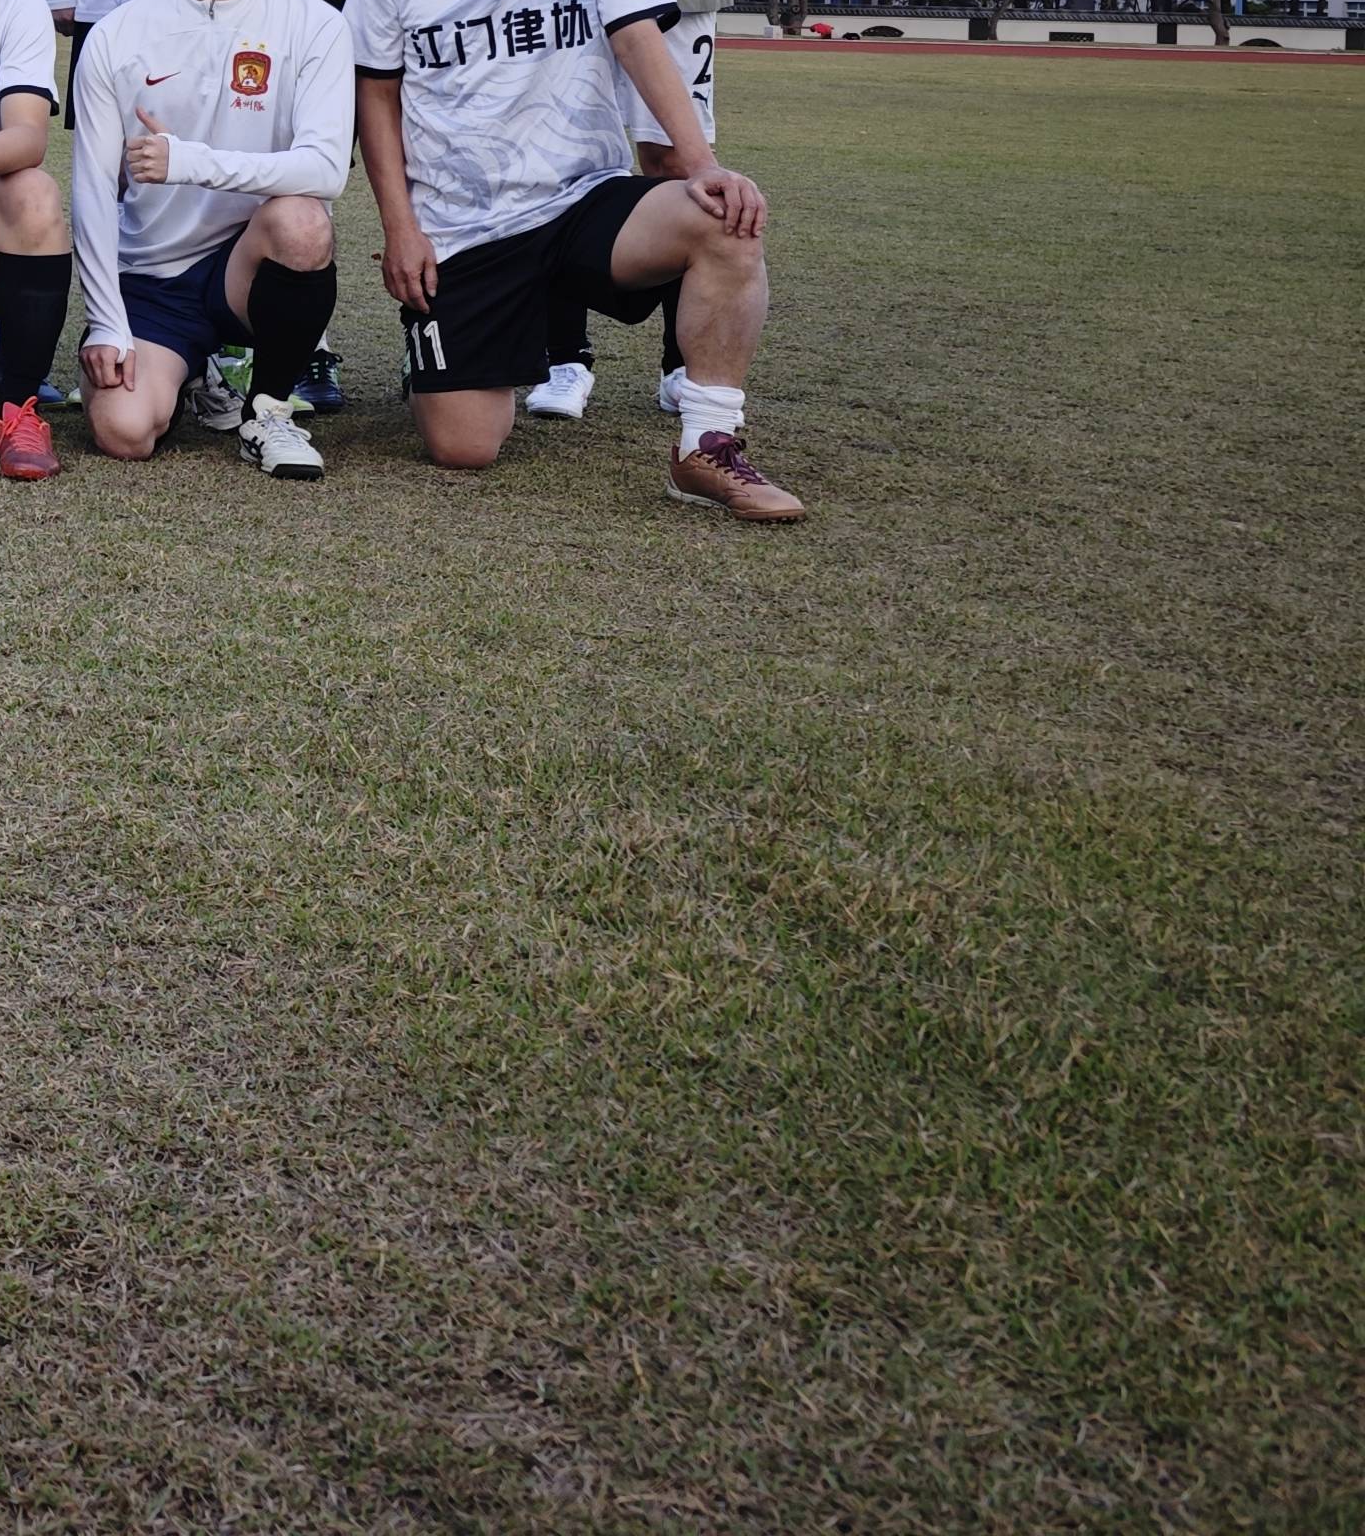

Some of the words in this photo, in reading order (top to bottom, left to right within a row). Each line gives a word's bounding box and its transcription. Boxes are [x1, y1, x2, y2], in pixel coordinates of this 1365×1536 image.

[408, 0, 594, 69] 江门律协
[692, 34, 714, 85] 2
[411, 320, 447, 371] 11
